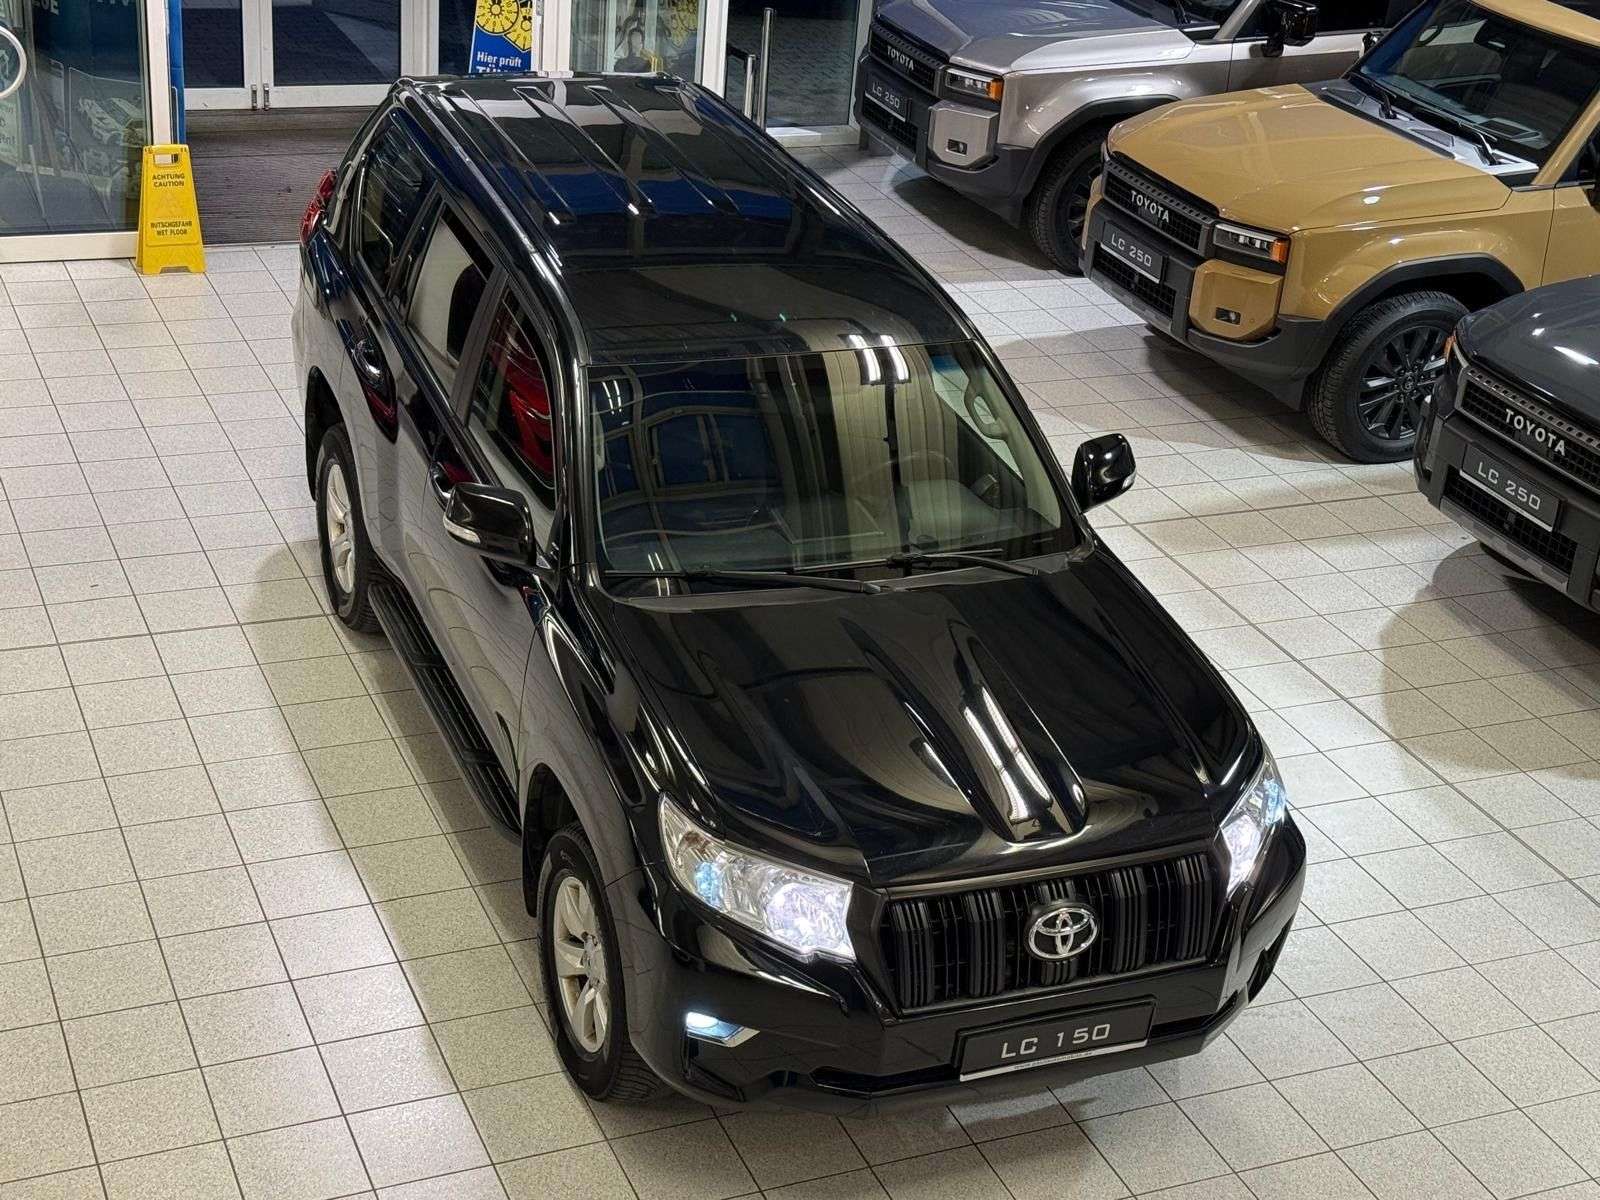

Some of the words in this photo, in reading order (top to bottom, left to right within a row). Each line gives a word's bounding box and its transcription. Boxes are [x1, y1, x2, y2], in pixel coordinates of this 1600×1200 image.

[477, 51, 498, 63] Hier
[499, 56, 522, 68] prüft
[887, 45, 914, 71] TOYOTA
[872, 82, 882, 97] LC
[884, 92, 900, 109] 250
[1131, 190, 1169, 223] TOYOTA
[170, 228, 188, 236] FLOOR
[1111, 233, 1126, 251] LC
[1129, 245, 1152, 267] 250
[1505, 408, 1565, 456] TOYOTA
[1478, 461, 1499, 485] LC
[1505, 480, 1541, 510] 250
[1001, 1037, 1039, 1059] LC
[1056, 1023, 1111, 1048] 150
